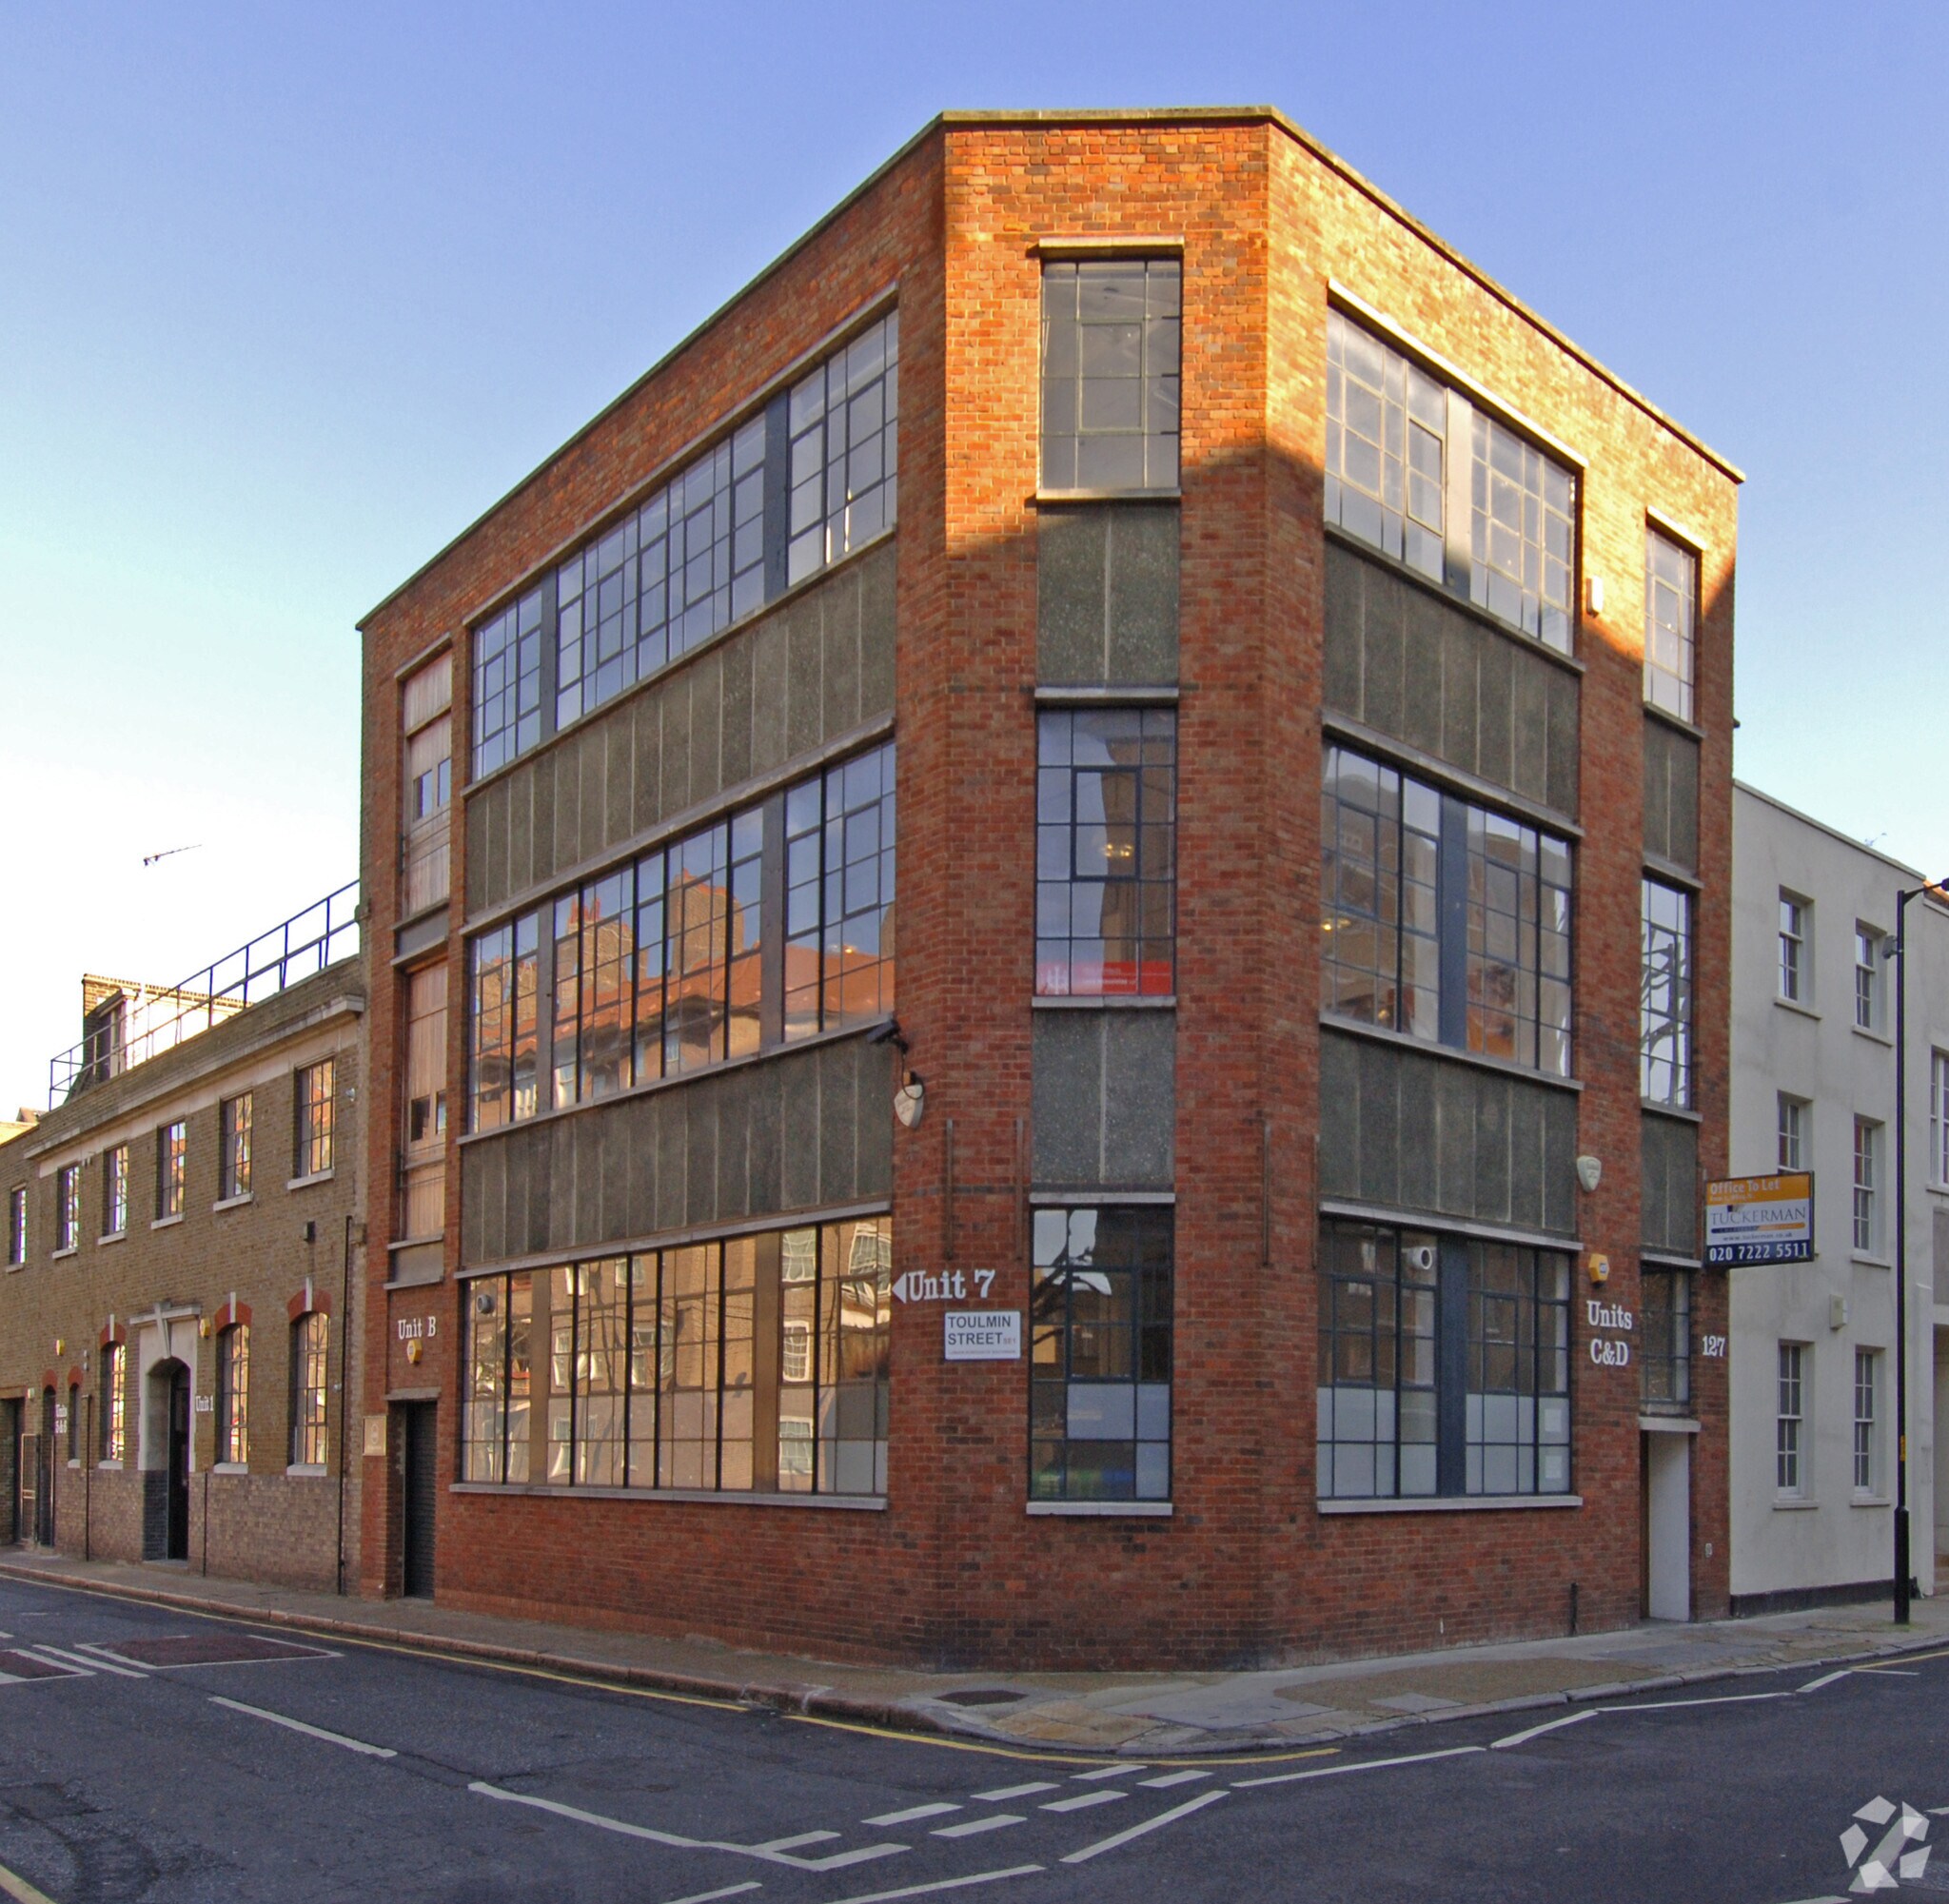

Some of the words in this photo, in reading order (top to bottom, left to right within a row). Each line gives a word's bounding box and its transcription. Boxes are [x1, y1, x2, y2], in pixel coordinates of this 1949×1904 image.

[1710, 1181, 1744, 1194] Office
[1747, 1179, 1760, 1191] To
[1762, 1177, 1781, 1190] Let
[1710, 1207, 1806, 1226] TUCKERMAN
[1709, 1246, 1734, 1262] 020
[1738, 1245, 1770, 1260] 7222
[1776, 1243, 1808, 1258] 5511
[908, 1269, 967, 1302] Unit
[974, 1268, 995, 1299] 7
[947, 1315, 1012, 1328] TOULMIN
[1586, 1300, 1633, 1330] Units
[398, 1318, 423, 1340] Unit
[427, 1316, 436, 1337] B
[948, 1332, 1003, 1345] STREET
[1702, 1335, 1725, 1358] 127
[1590, 1338, 1629, 1366] C&D
[195, 1395, 209, 1412] Unit
[209, 1395, 214, 1412] 1
